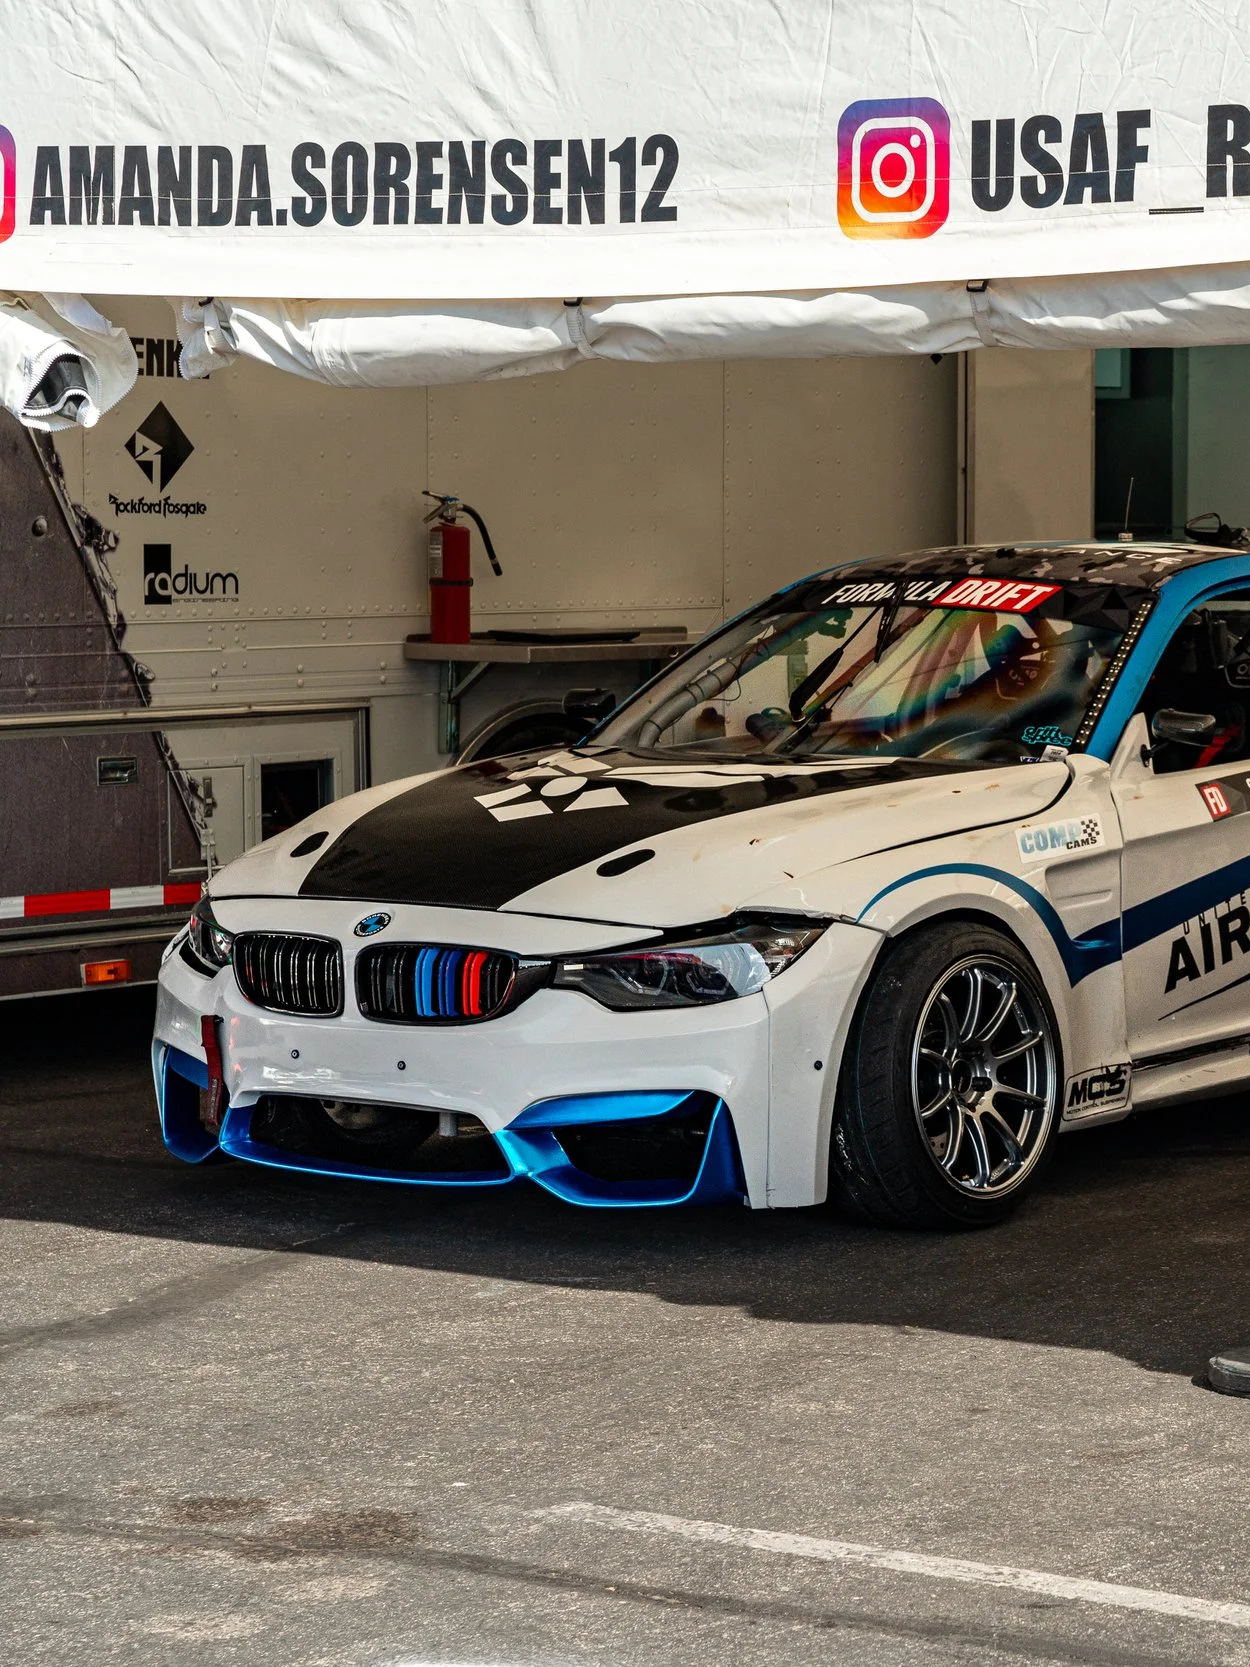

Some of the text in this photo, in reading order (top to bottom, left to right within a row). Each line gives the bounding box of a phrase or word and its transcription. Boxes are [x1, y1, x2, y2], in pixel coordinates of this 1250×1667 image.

[30, 133, 679, 227] AMANDA.SORENSEN12
[144, 564, 239, 597] radium
[940, 578, 1054, 611] DRIFT
[1202, 786, 1229, 817] FD
[1066, 835, 1098, 850] CAMS
